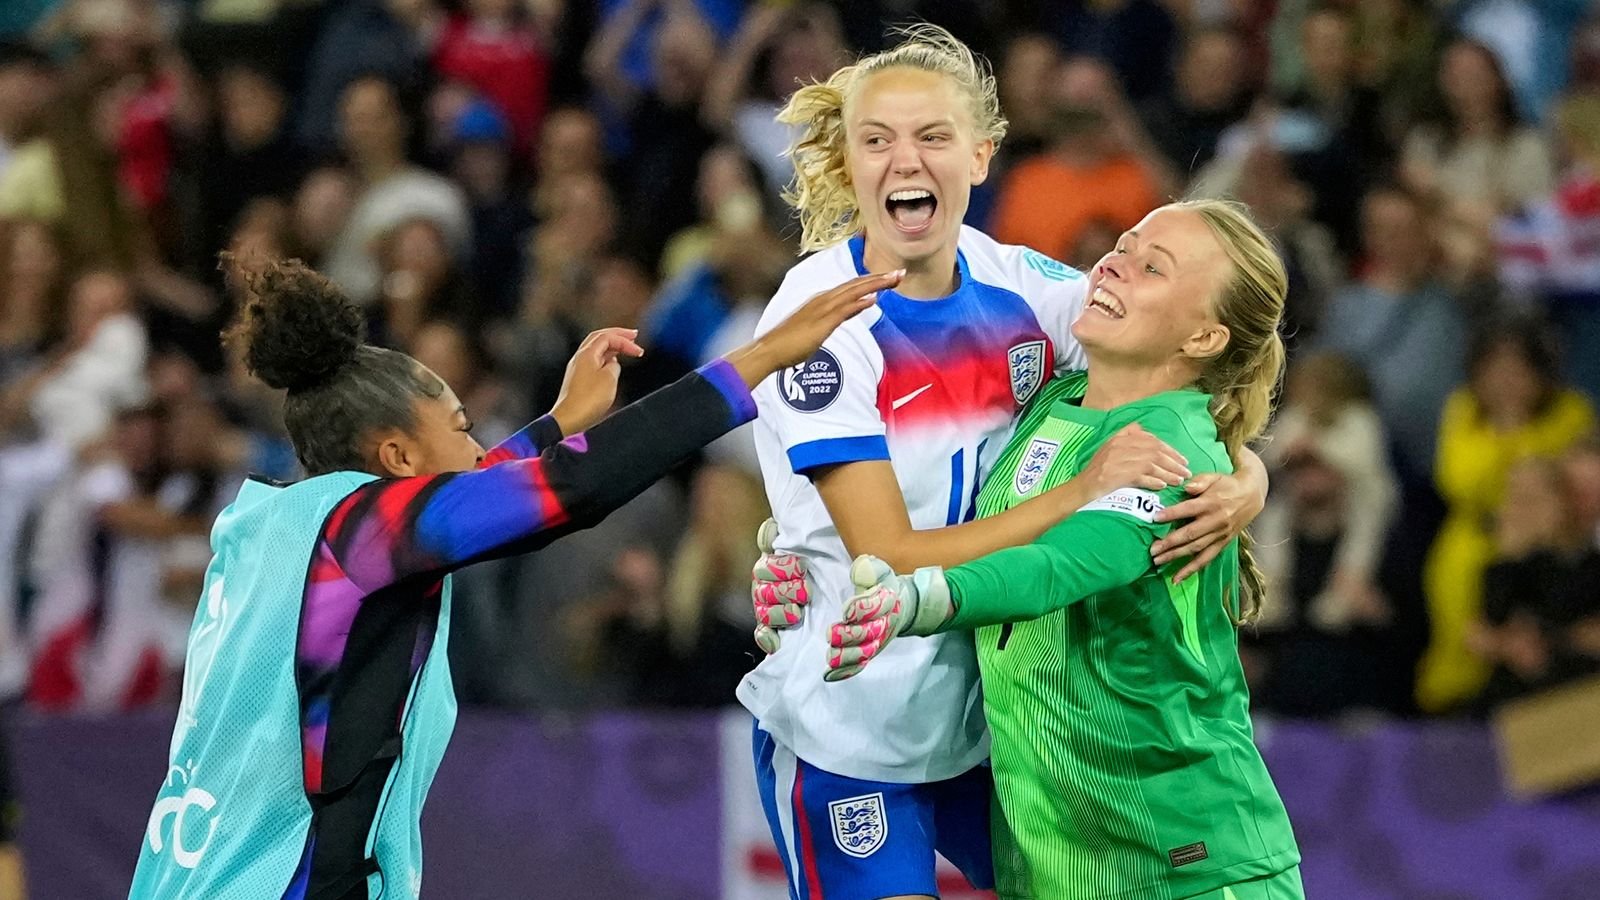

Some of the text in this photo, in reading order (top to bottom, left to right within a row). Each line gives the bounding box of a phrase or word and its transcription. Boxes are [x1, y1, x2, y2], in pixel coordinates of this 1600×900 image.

[803, 371, 837, 379] EUROPEAN
[801, 378, 838, 386] CHAMPIONS
[809, 386, 831, 394] 2022
[1107, 495, 1134, 504] ATION
[1136, 495, 1154, 513] 10
